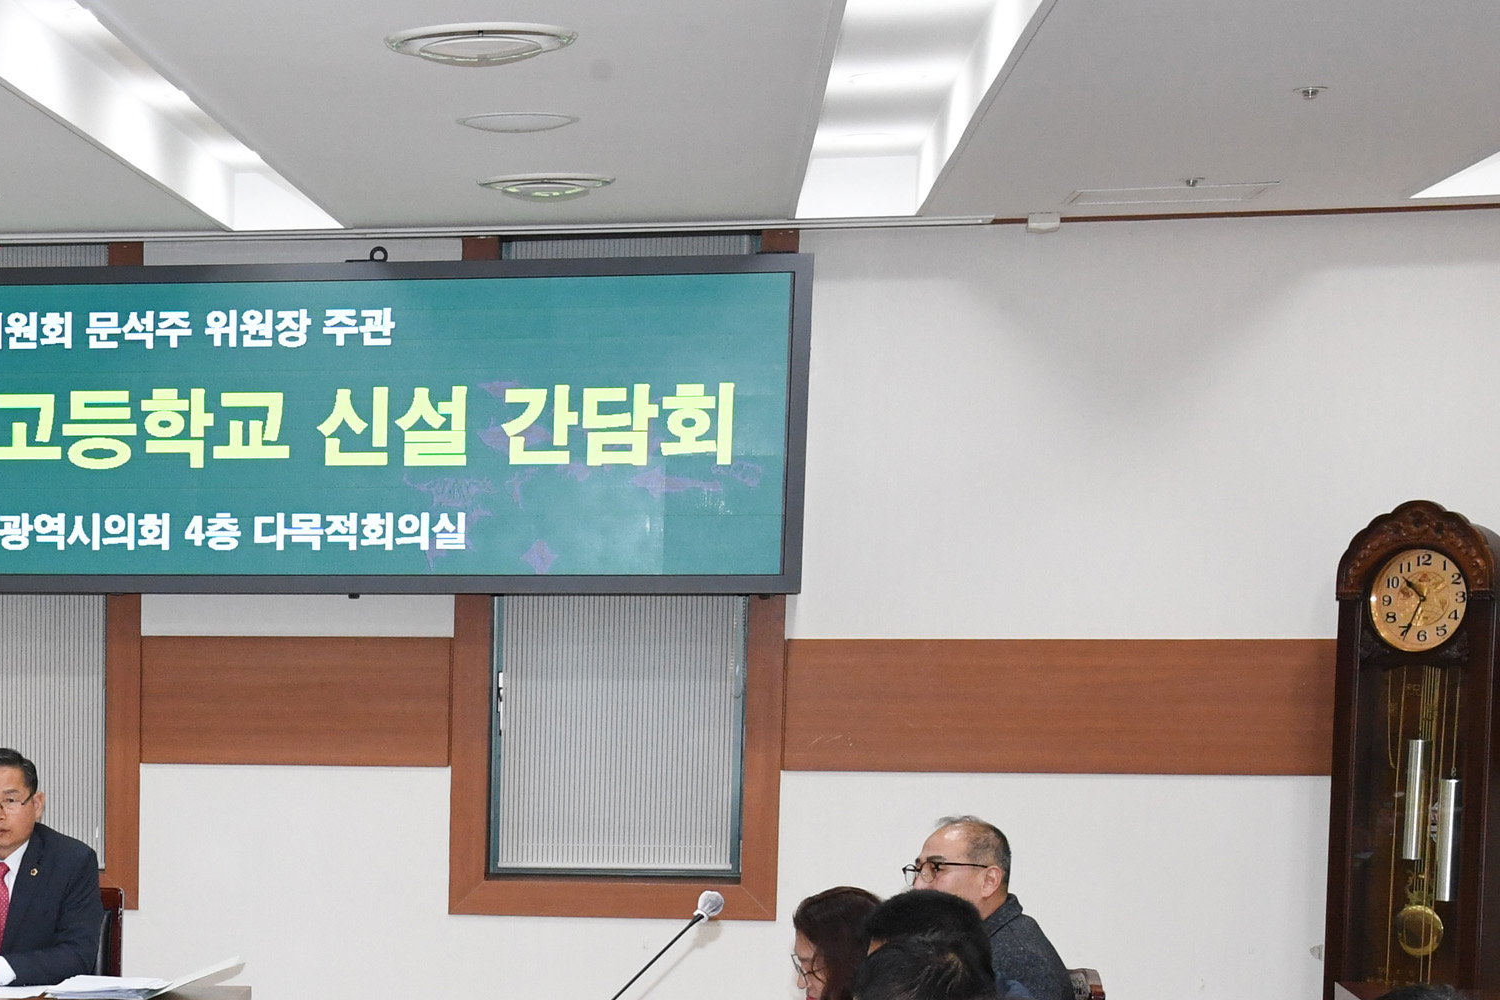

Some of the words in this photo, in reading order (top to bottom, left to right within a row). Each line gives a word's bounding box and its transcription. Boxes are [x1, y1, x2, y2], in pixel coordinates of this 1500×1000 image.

[86, 311, 192, 349] 문석주
[205, 309, 311, 347] 위원장
[323, 308, 395, 346] 주관
[317, 386, 467, 466] 신설
[501, 383, 735, 466] 간담회
[185, 513, 241, 550] 4층
[254, 512, 466, 550] 다목적회의실
[1417, 554, 1432, 566] 12
[1443, 560, 1446, 570] 1
[1400, 562, 1411, 573] 11
[1387, 576, 1399, 588] 10
[1451, 573, 1461, 584] 2
[1382, 595, 1392, 606] 9
[1456, 591, 1466, 603] 3
[1386, 612, 1396, 623] 8
[1448, 610, 1459, 620] 4
[1417, 630, 1427, 641] 6
[1436, 624, 1447, 636] 5
